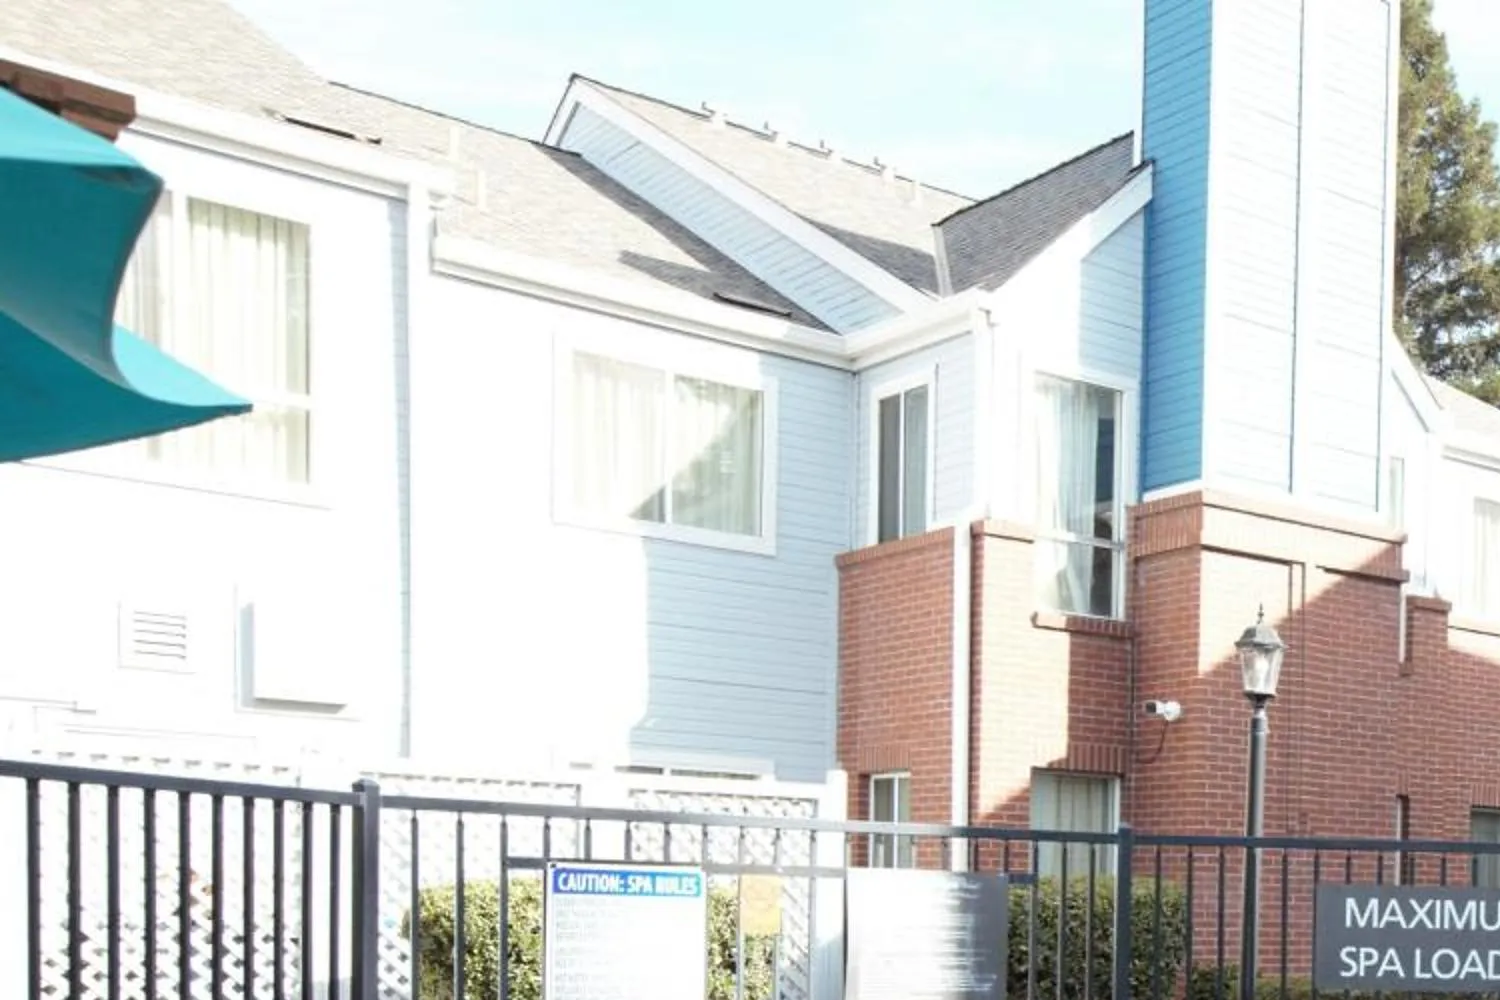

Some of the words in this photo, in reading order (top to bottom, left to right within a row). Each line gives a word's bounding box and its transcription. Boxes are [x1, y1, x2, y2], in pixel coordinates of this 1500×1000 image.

[558, 871, 625, 894] CAUTION:
[627, 873, 654, 895] SPA
[655, 875, 697, 896] RULES
[1339, 946, 1405, 979] SPA
